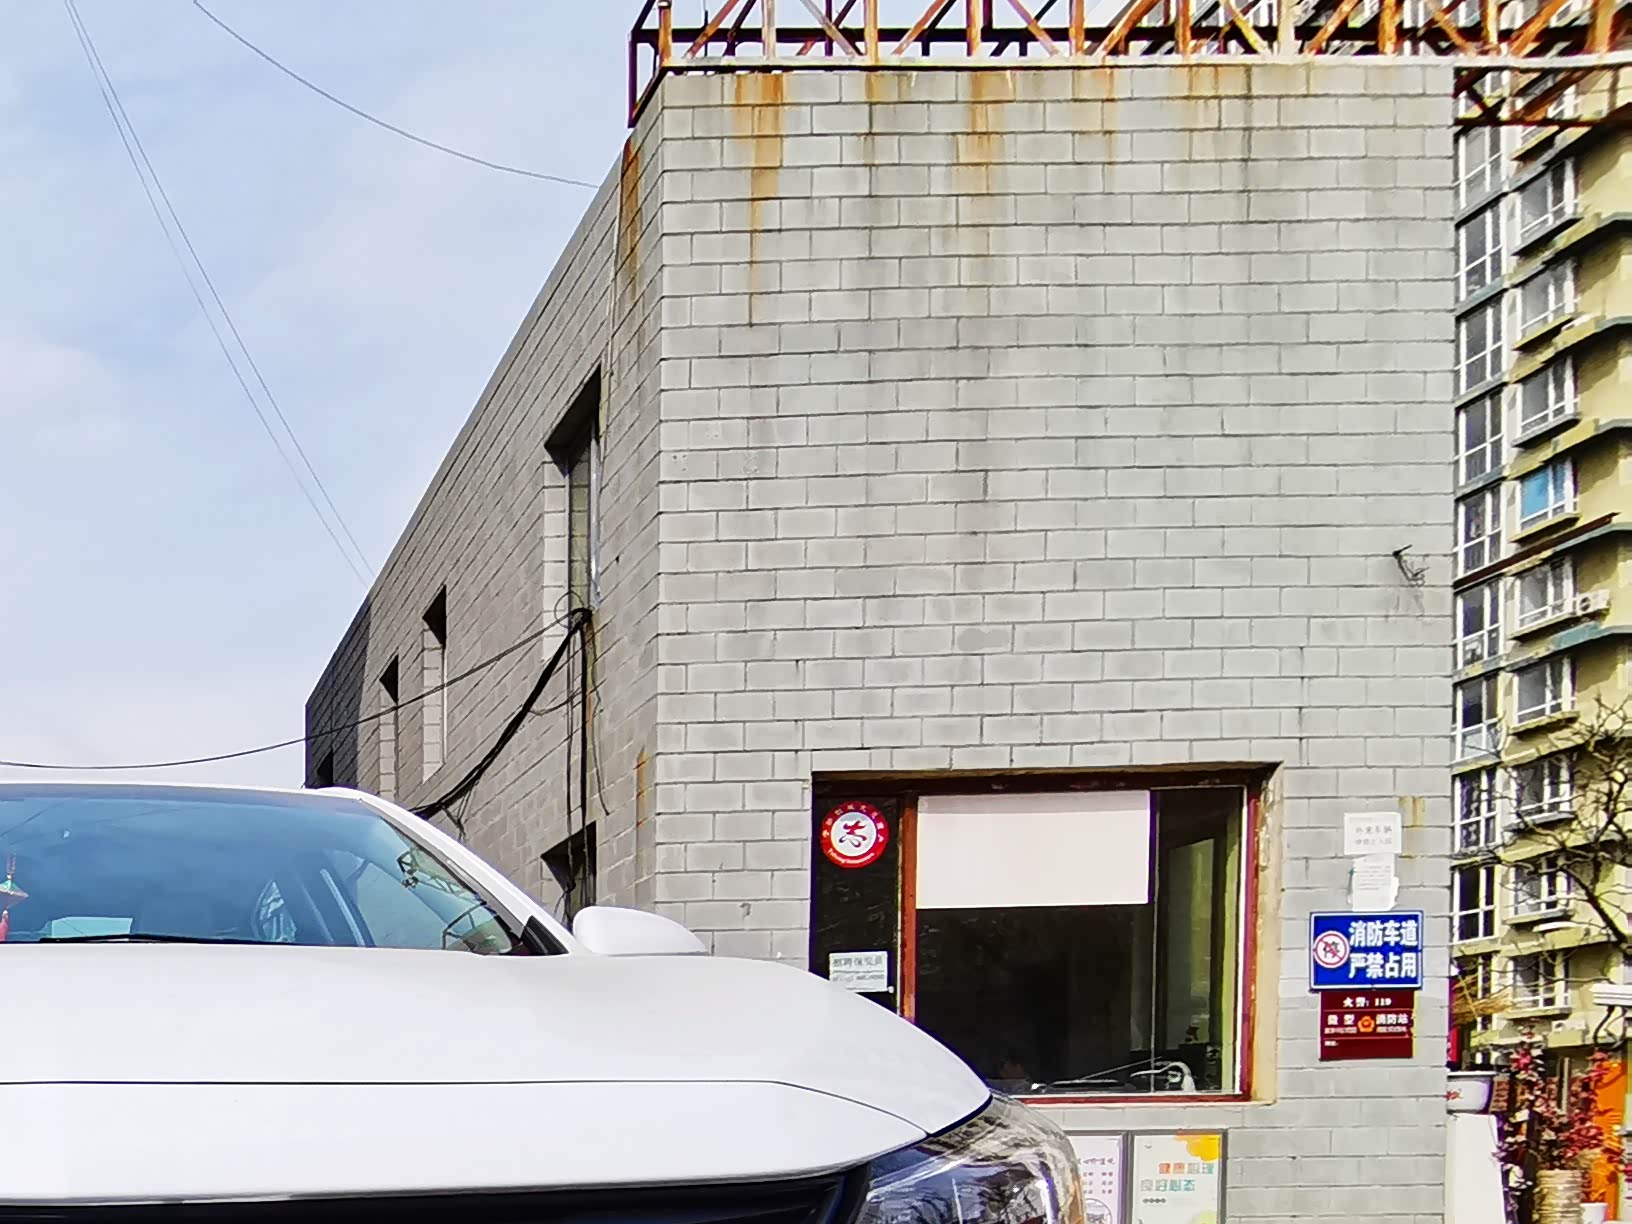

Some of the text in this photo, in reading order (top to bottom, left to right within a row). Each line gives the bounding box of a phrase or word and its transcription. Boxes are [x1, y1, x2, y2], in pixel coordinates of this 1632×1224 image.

[1349, 920, 1418, 947] 消防车道
[1349, 952, 1417, 978] 严禁占用
